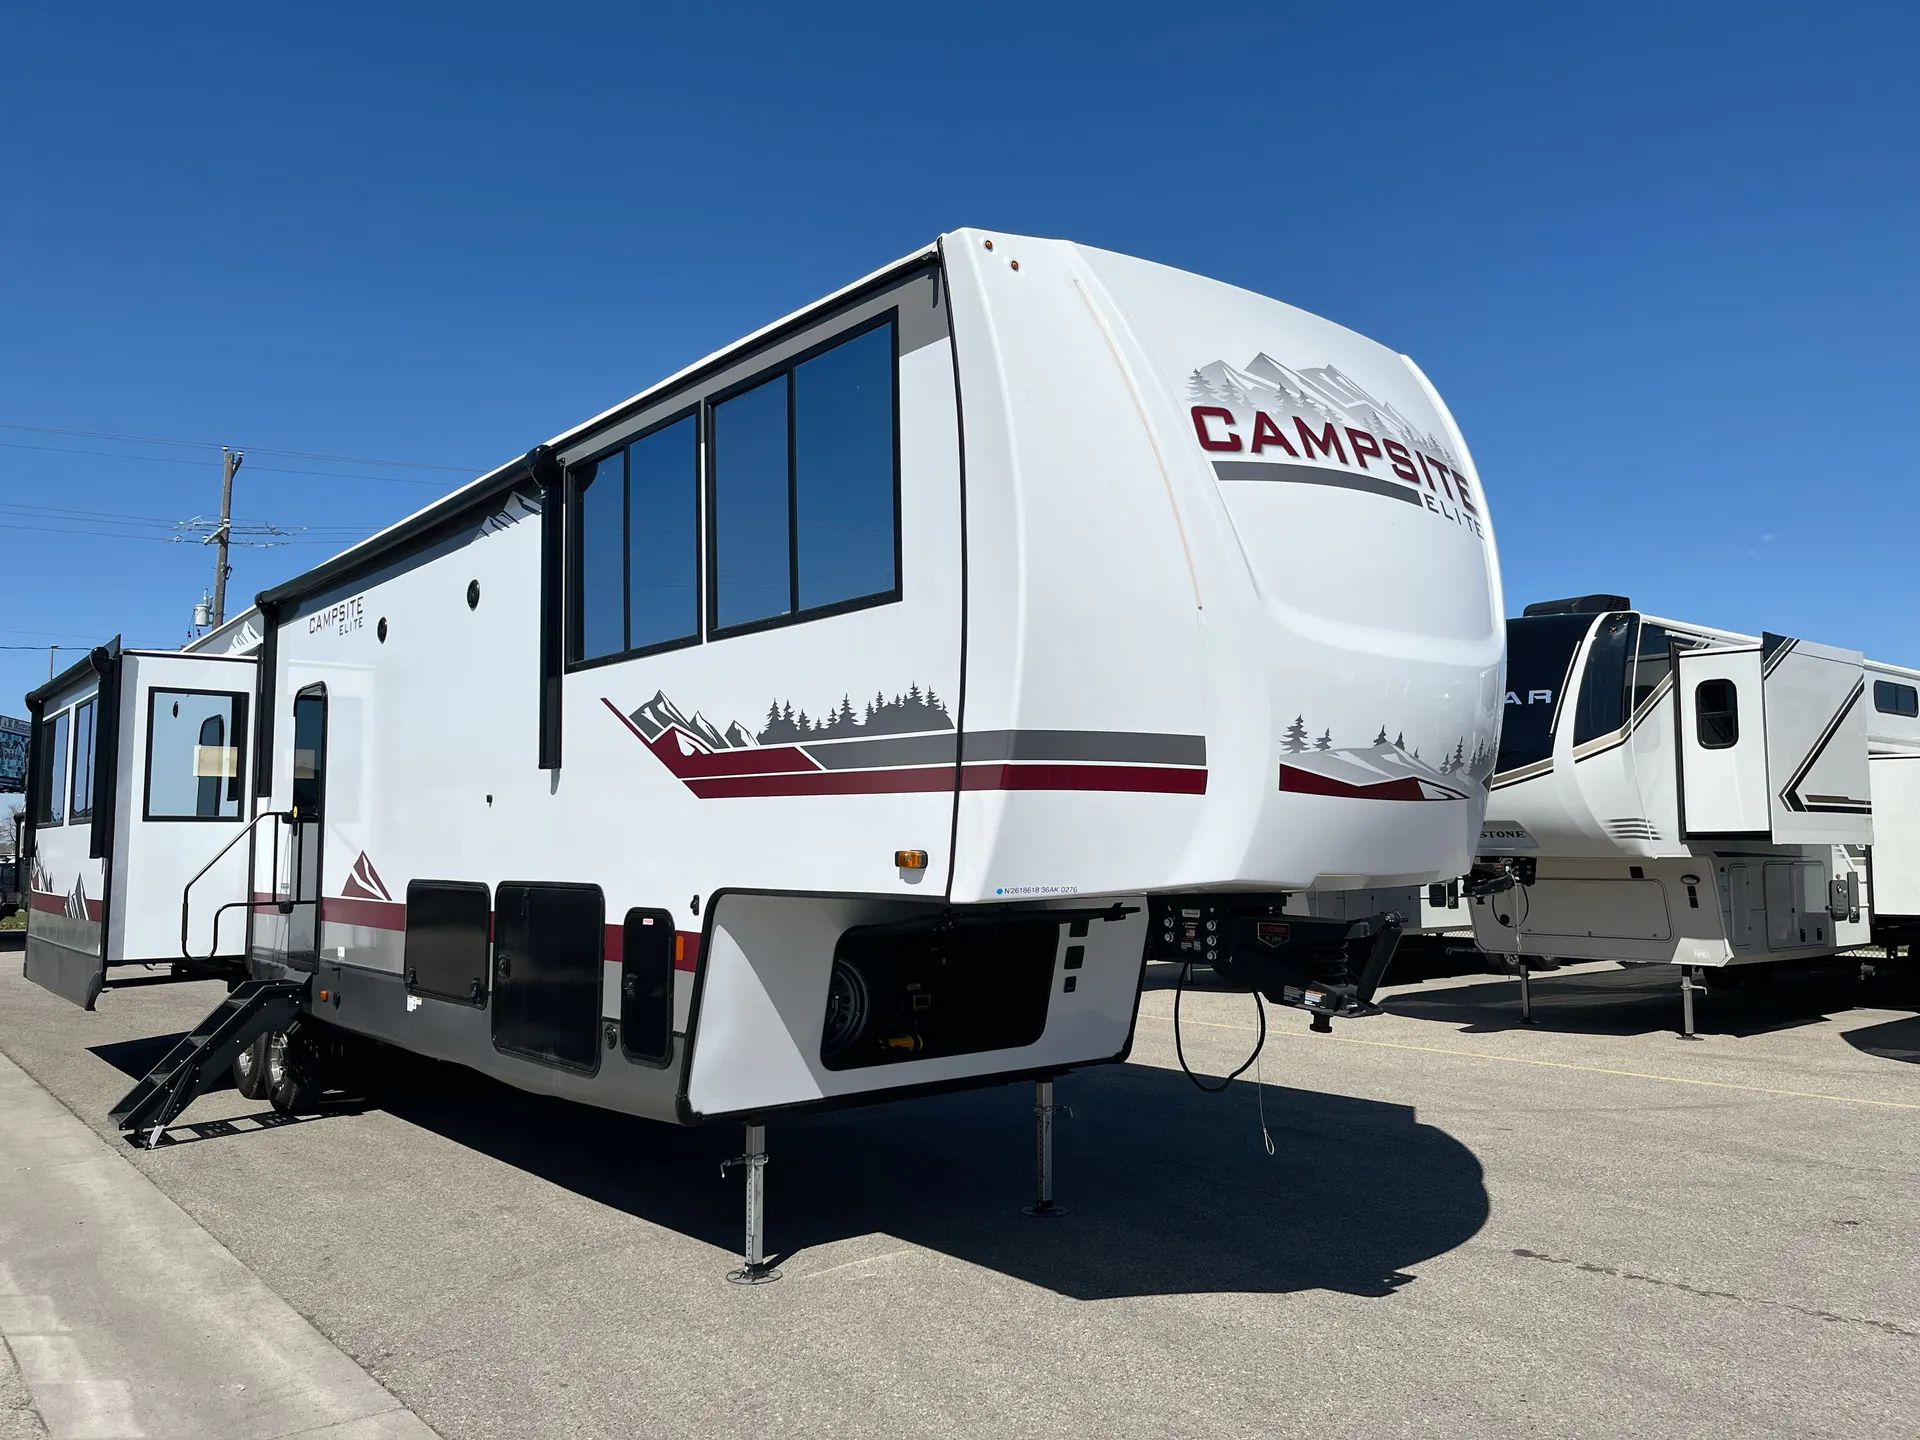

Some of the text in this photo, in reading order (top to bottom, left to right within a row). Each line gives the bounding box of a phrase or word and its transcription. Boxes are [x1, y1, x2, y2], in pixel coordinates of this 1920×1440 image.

[1190, 405, 1479, 517] CAMPSITE
[1422, 492, 1485, 541] ELITE
[309, 596, 364, 635] CAMPSITE
[339, 616, 364, 636] ELITE
